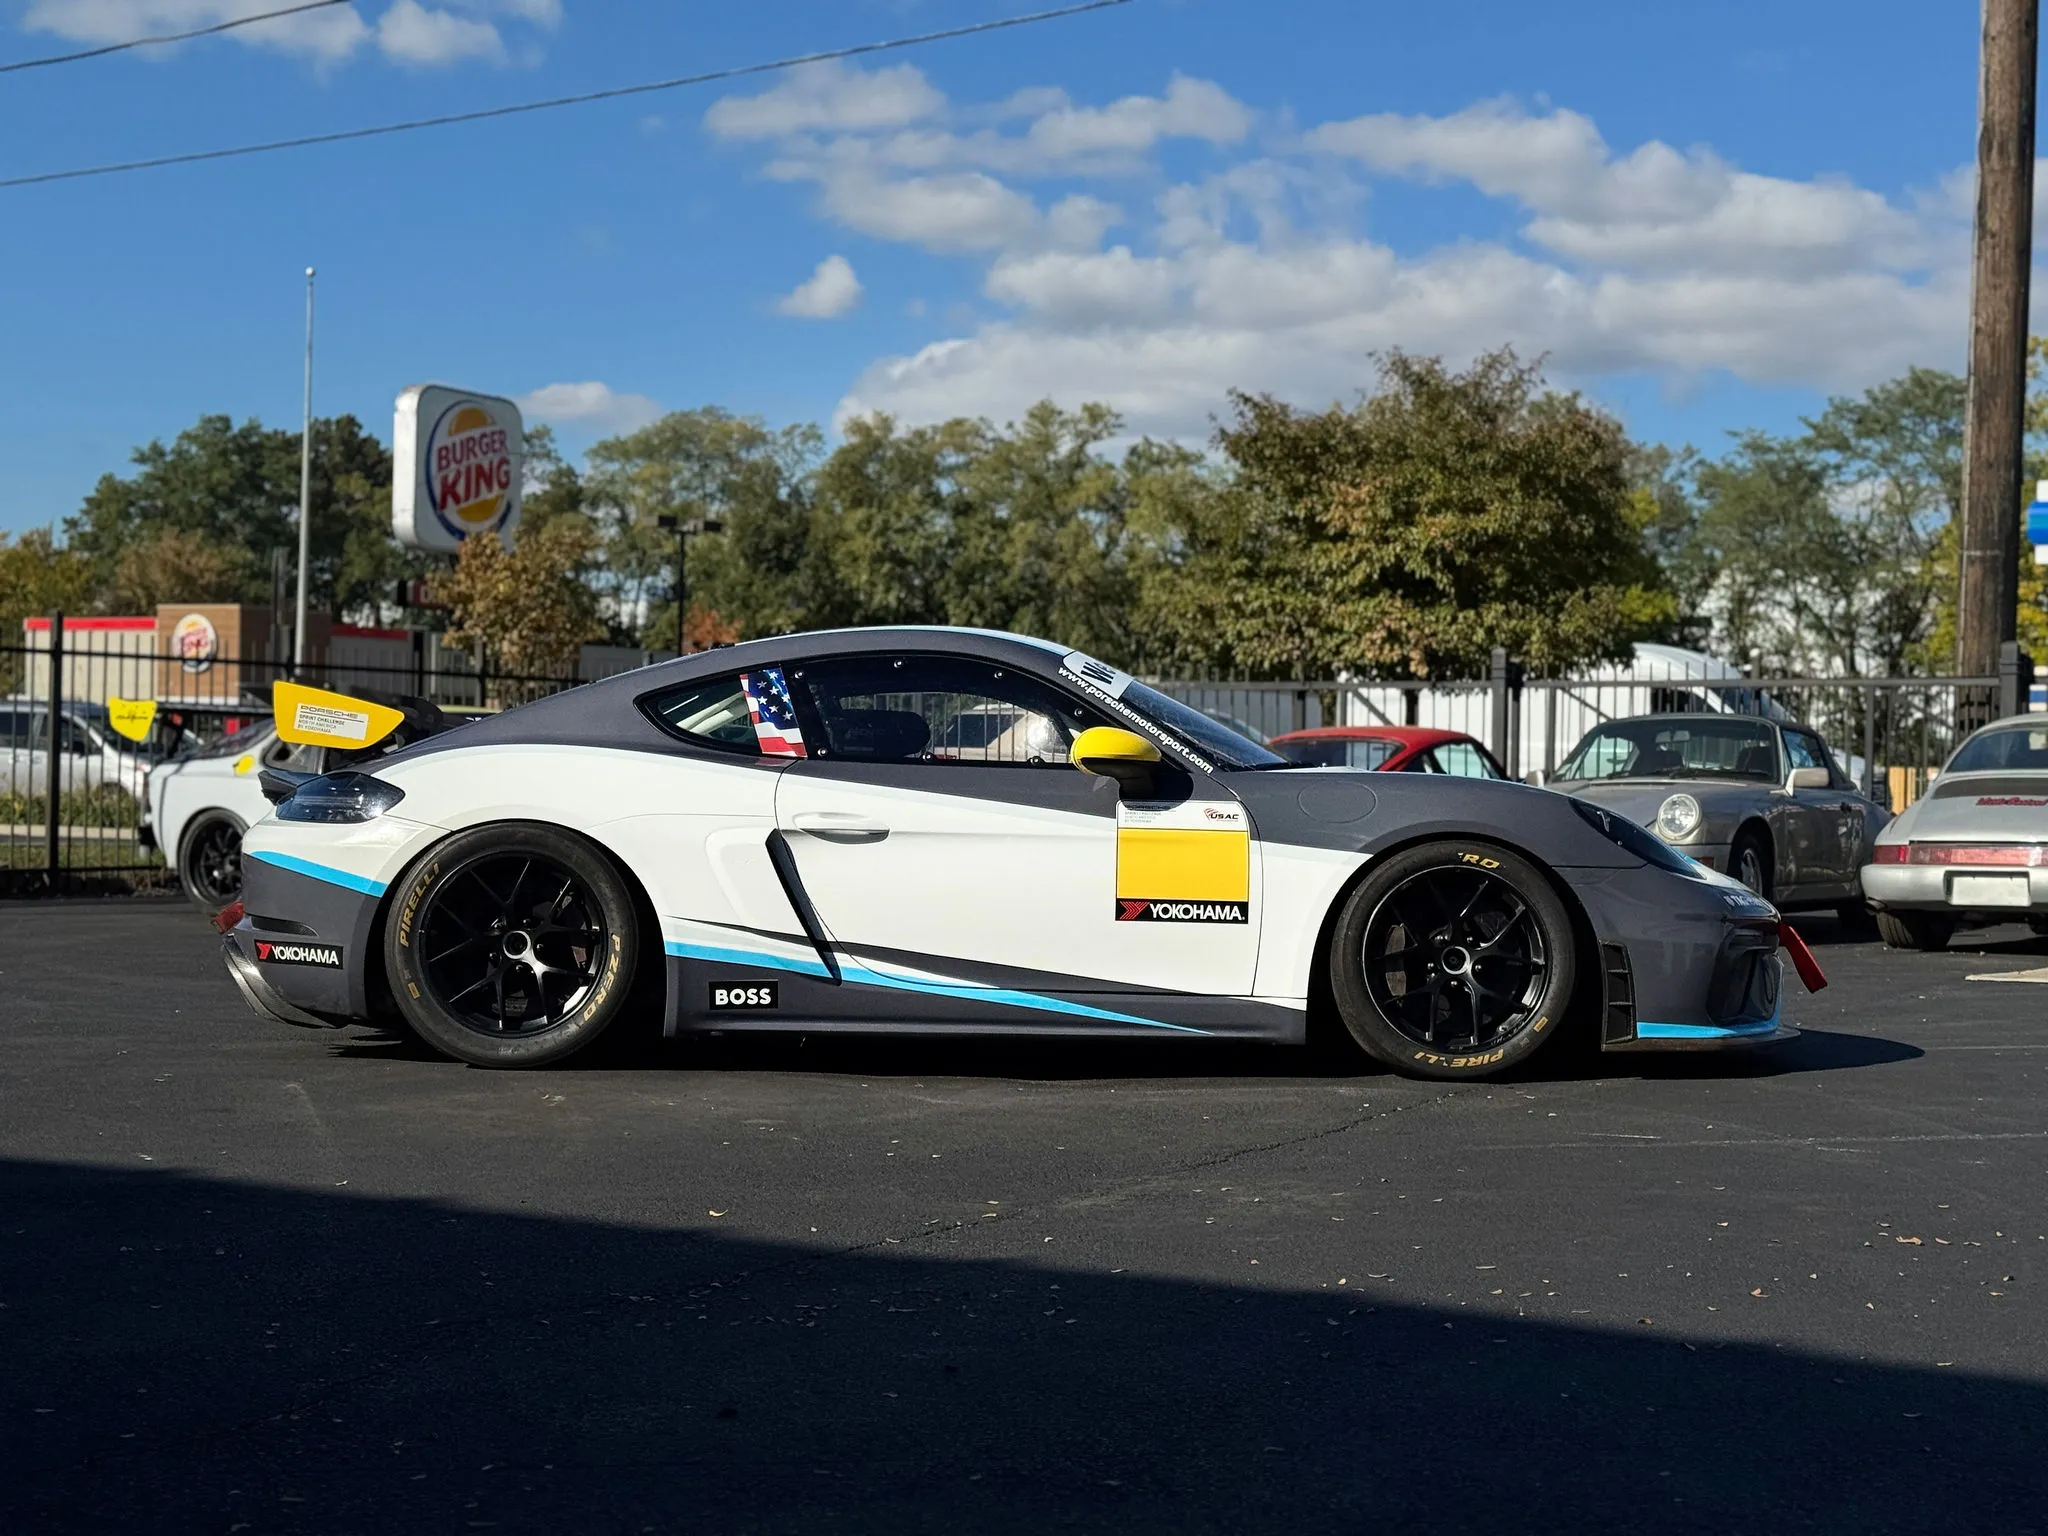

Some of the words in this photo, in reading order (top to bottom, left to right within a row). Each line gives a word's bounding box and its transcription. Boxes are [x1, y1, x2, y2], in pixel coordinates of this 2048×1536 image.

[437, 430, 508, 472] BURGER
[438, 456, 511, 511] KING
[300, 705, 358, 720] PORSCHE
[1058, 667, 1214, 775] www.porschemotorsport.com
[399, 863, 440, 948] PIRELLI
[1150, 903, 1242, 921] YOKOHAMA
[272, 945, 340, 965] YOKOHAMA
[715, 987, 772, 1005] BOSS
